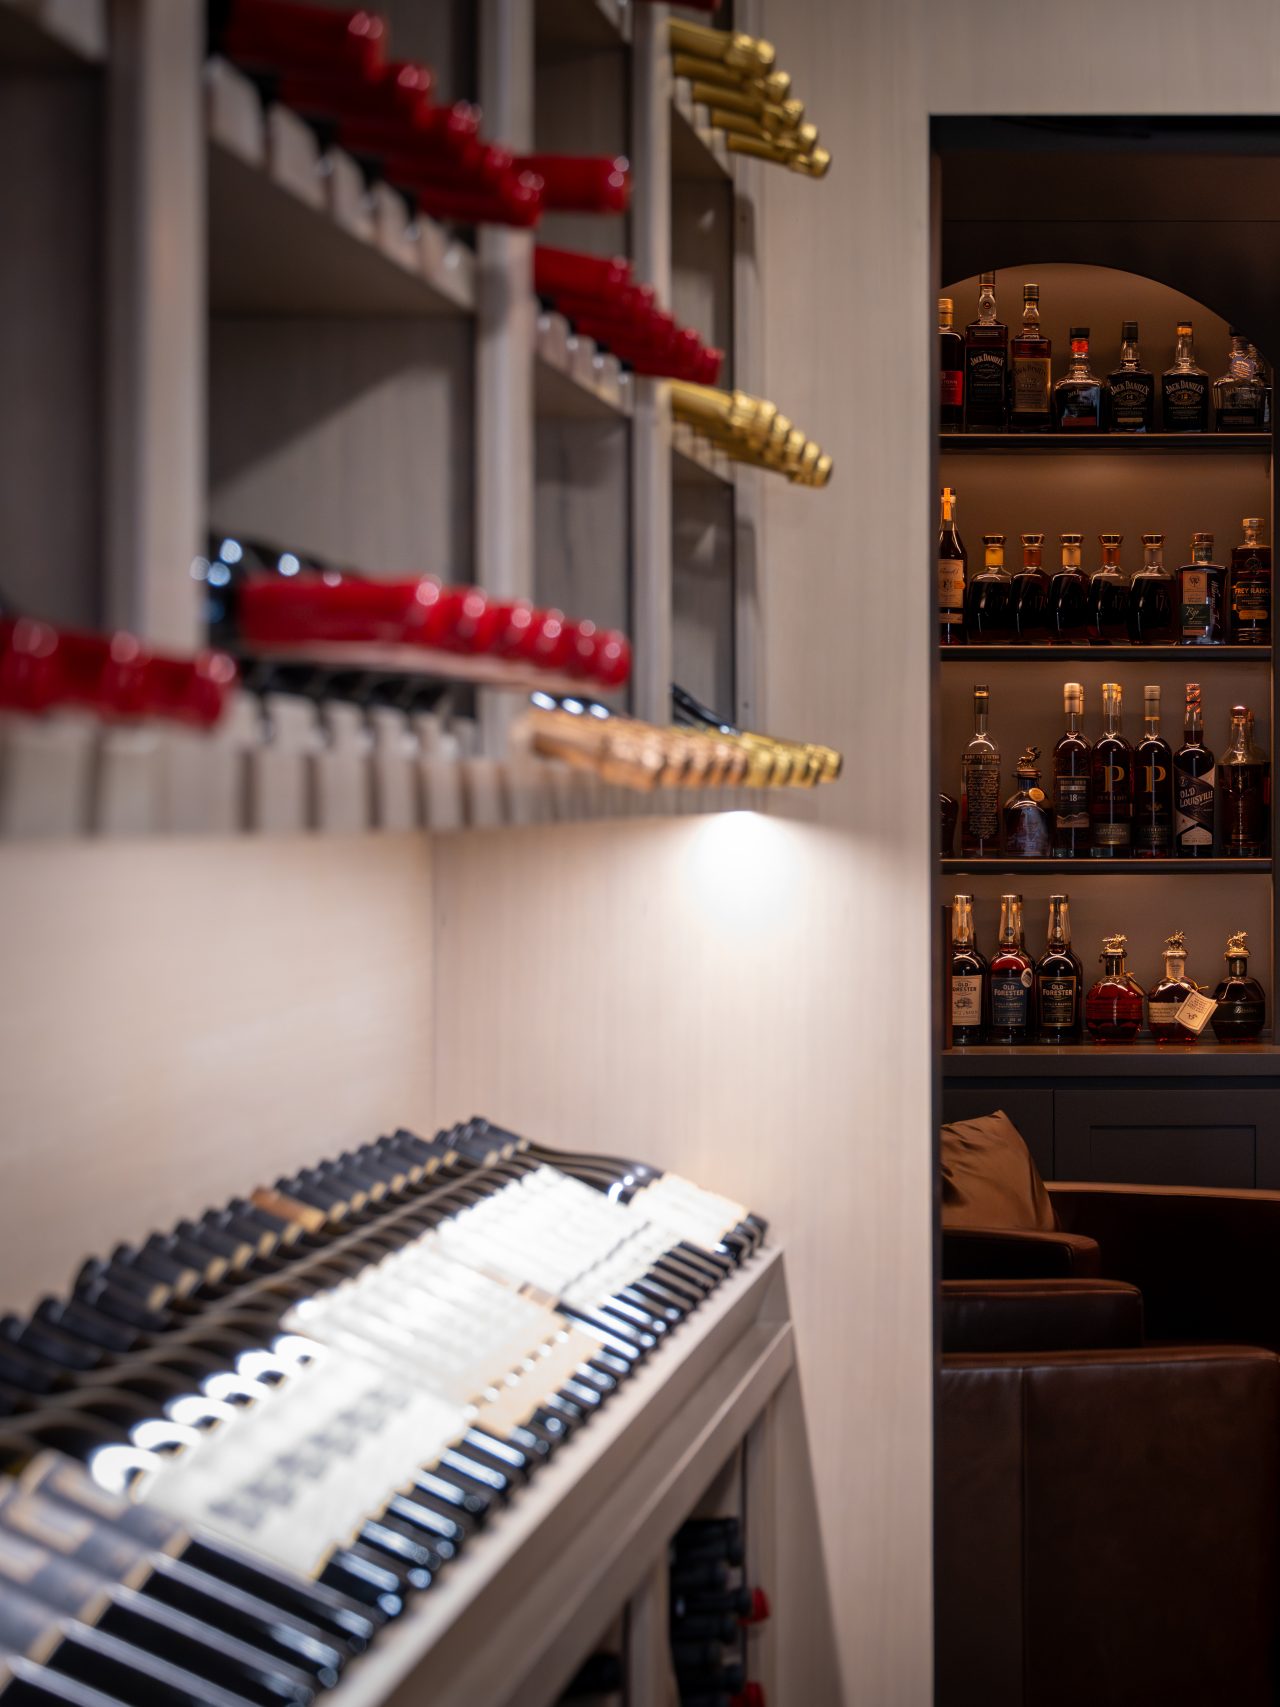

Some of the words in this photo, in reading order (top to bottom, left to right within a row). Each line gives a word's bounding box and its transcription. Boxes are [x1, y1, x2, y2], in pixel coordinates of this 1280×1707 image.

[1110, 384, 1126, 395] JACK
[1165, 383, 1180, 394] JACK
[1104, 765, 1125, 792] P
[1144, 765, 1166, 792] P
[1179, 785, 1196, 799] OLD
[1069, 794, 1078, 802] 18
[994, 989, 1025, 997] FORESTER
[1042, 989, 1073, 997] FORESTER
